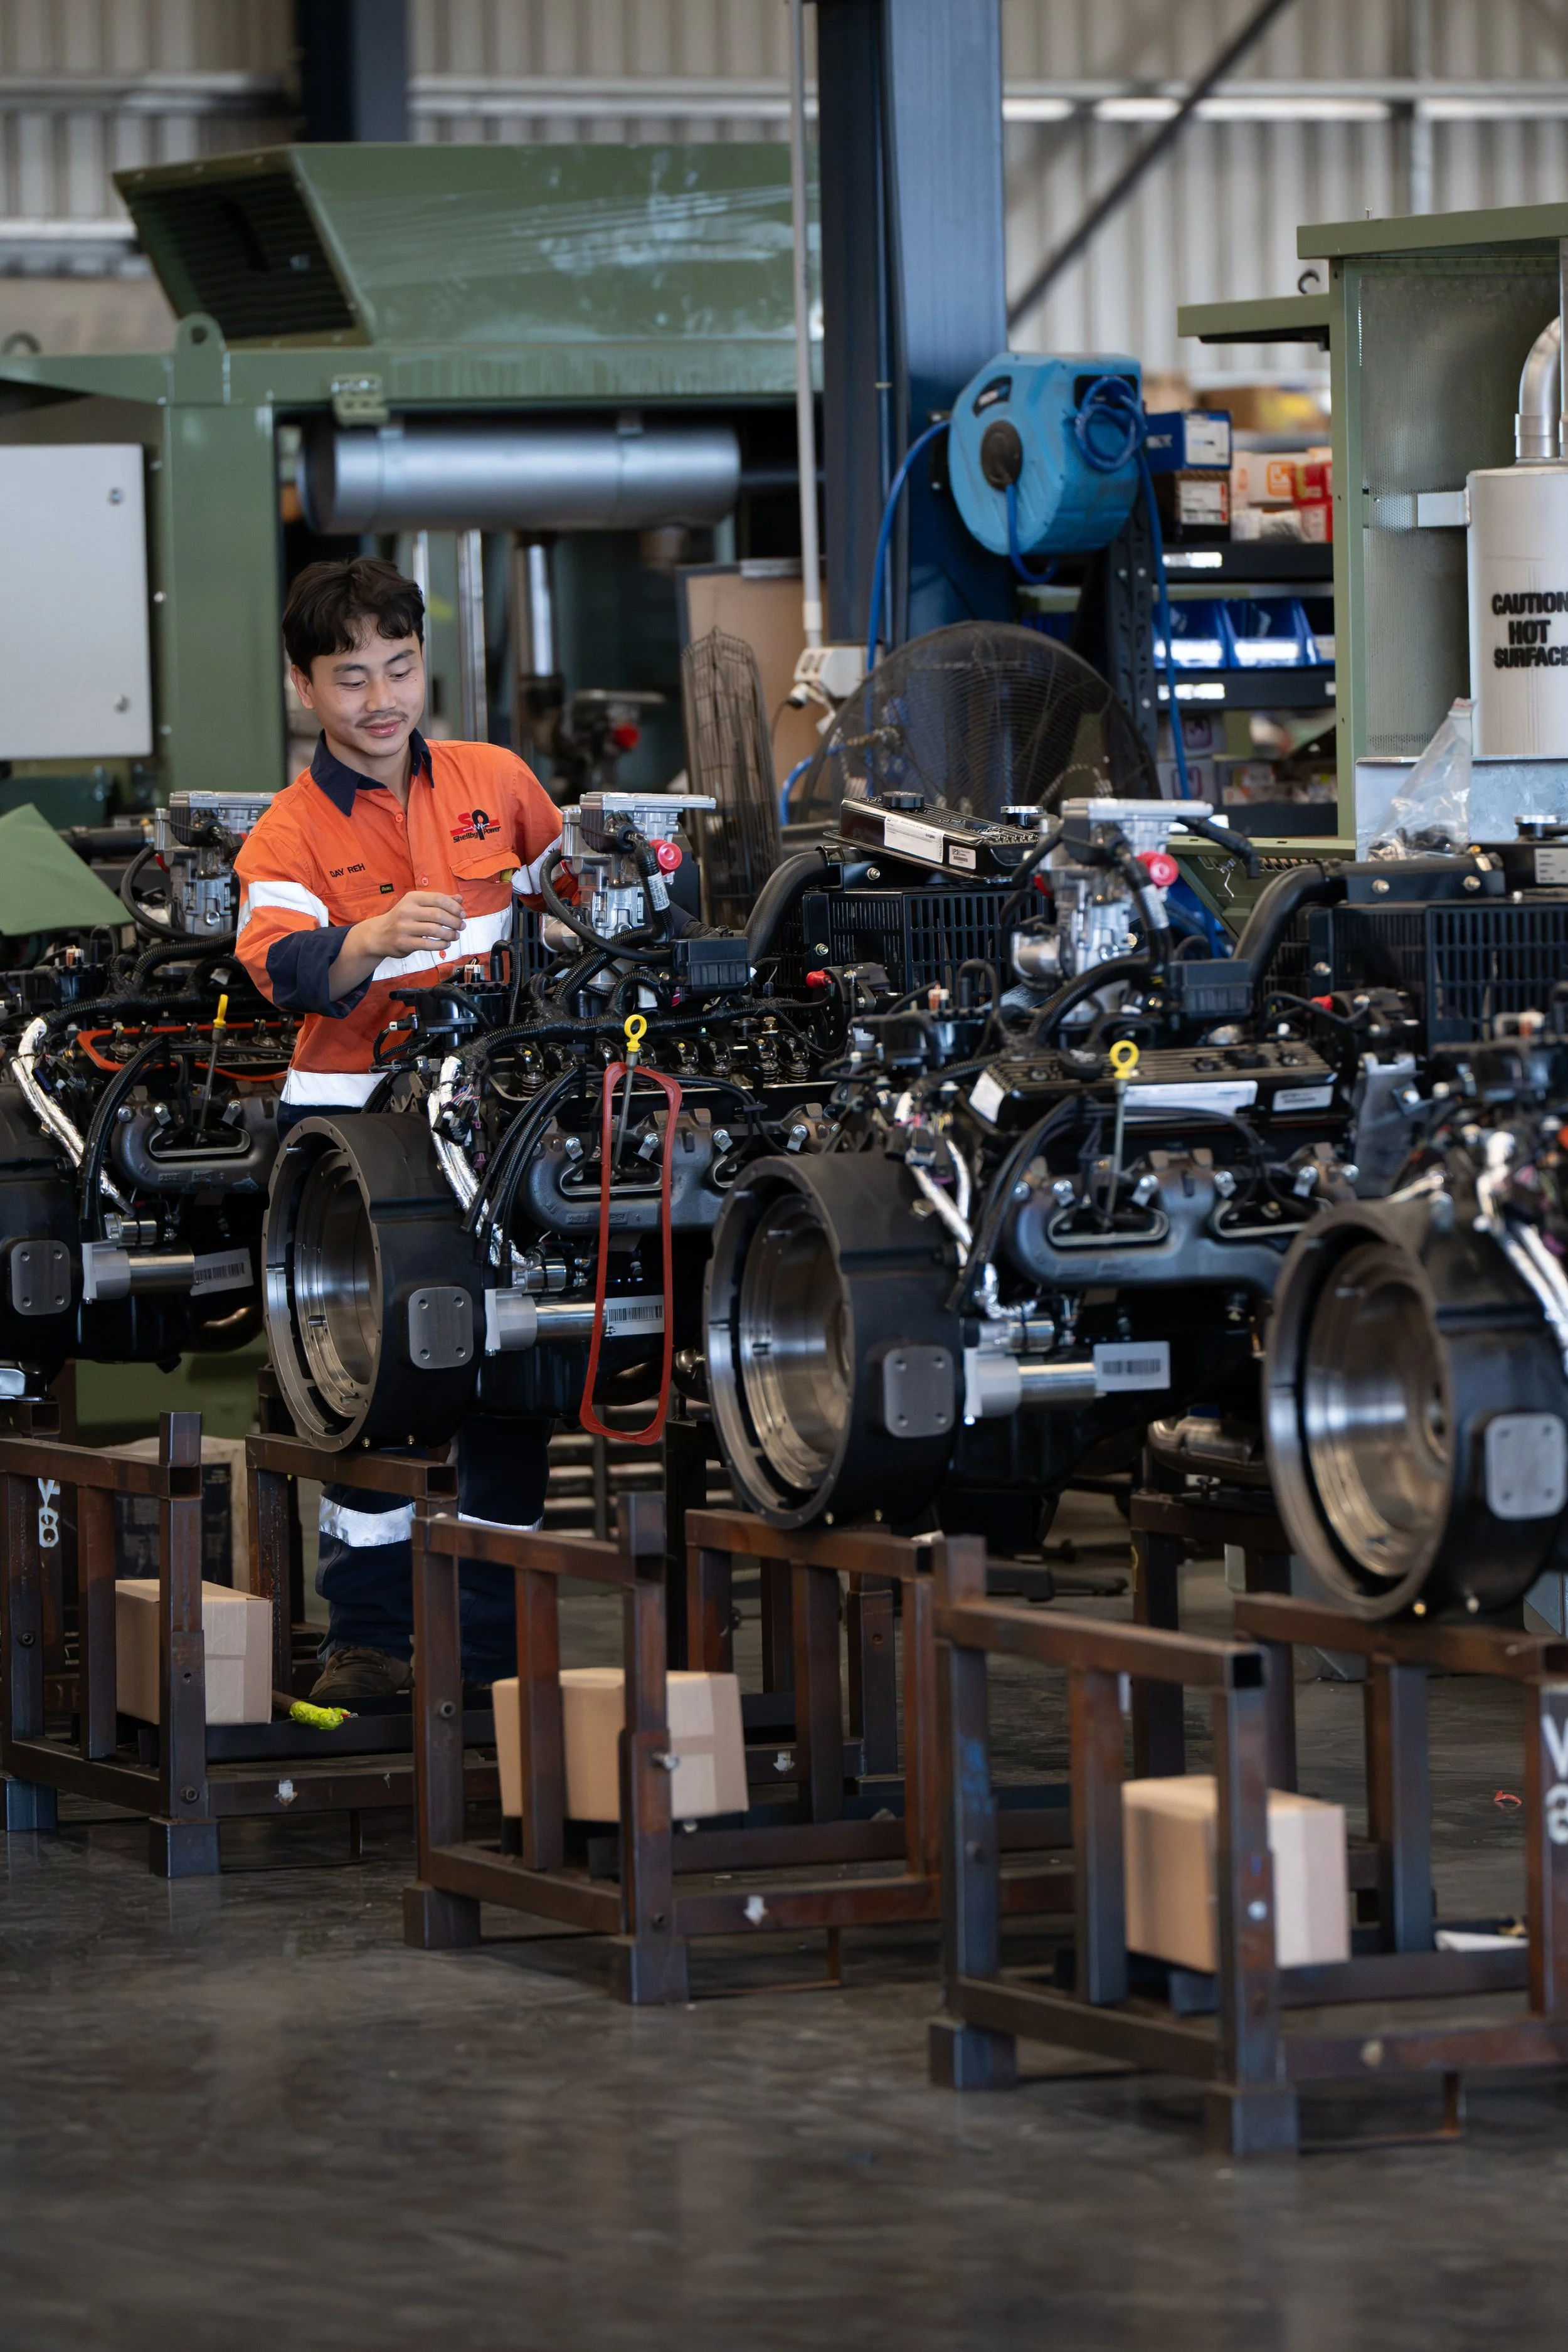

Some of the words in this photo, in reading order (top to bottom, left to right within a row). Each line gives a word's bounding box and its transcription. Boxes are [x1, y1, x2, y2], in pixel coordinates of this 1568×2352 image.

[1492, 591, 1568, 615] CAUTION
[1508, 620, 1550, 645] HOT
[1494, 645, 1568, 669] SURFACE
[484, 826, 501, 835] Power
[329, 868, 344, 877] DAY
[347, 863, 366, 874] REH
